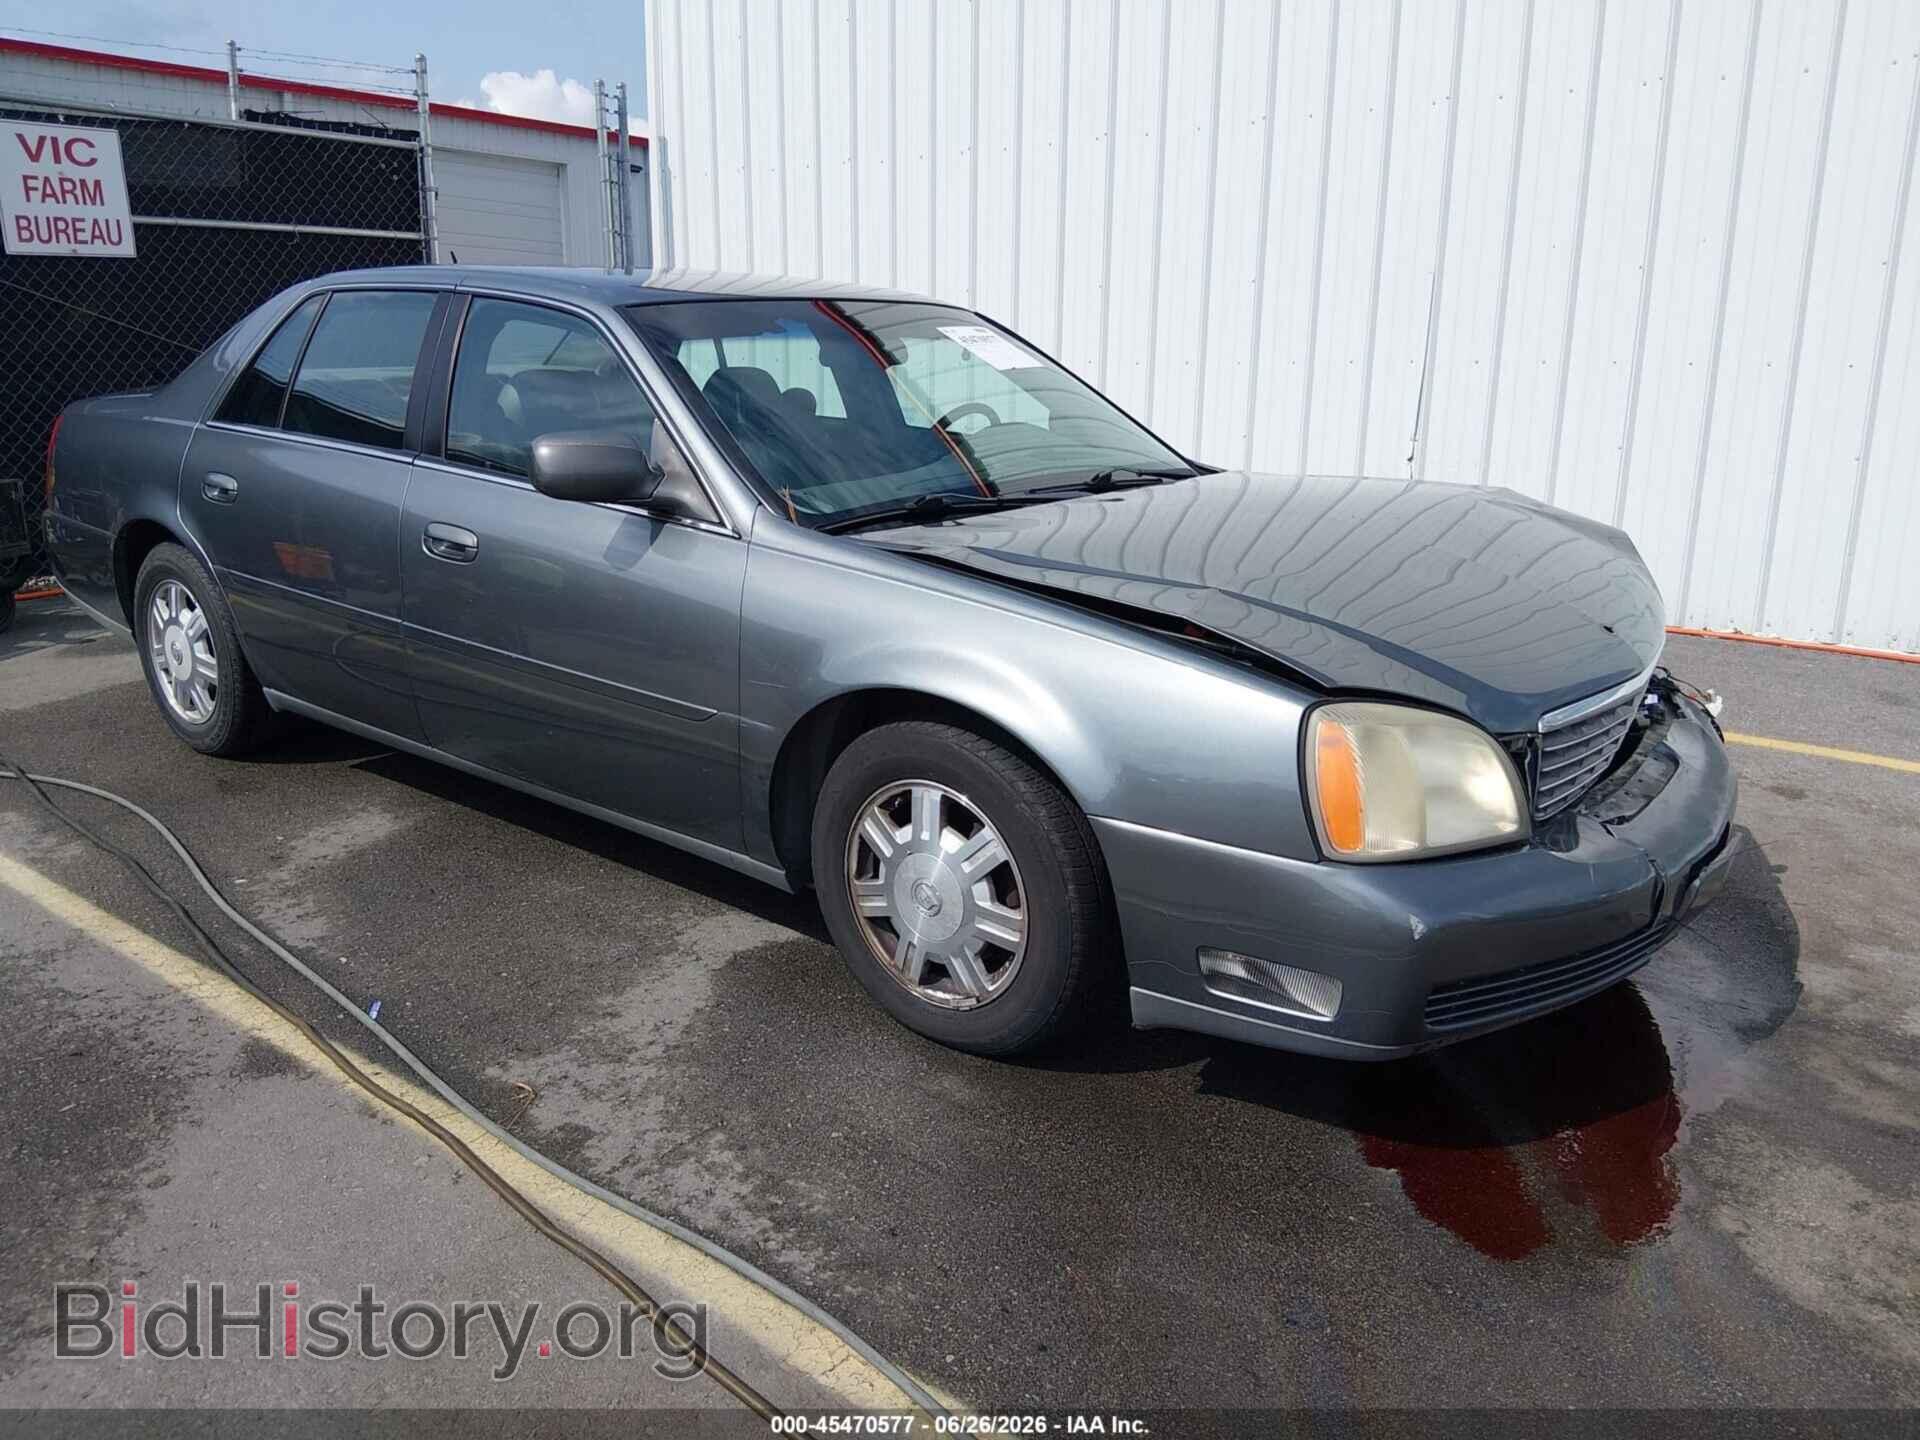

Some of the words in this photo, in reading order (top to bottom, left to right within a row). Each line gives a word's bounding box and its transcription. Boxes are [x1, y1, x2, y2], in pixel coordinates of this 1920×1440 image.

[15, 132, 98, 167] VIC
[21, 174, 105, 207] FARM
[15, 214, 123, 246] BUREAU
